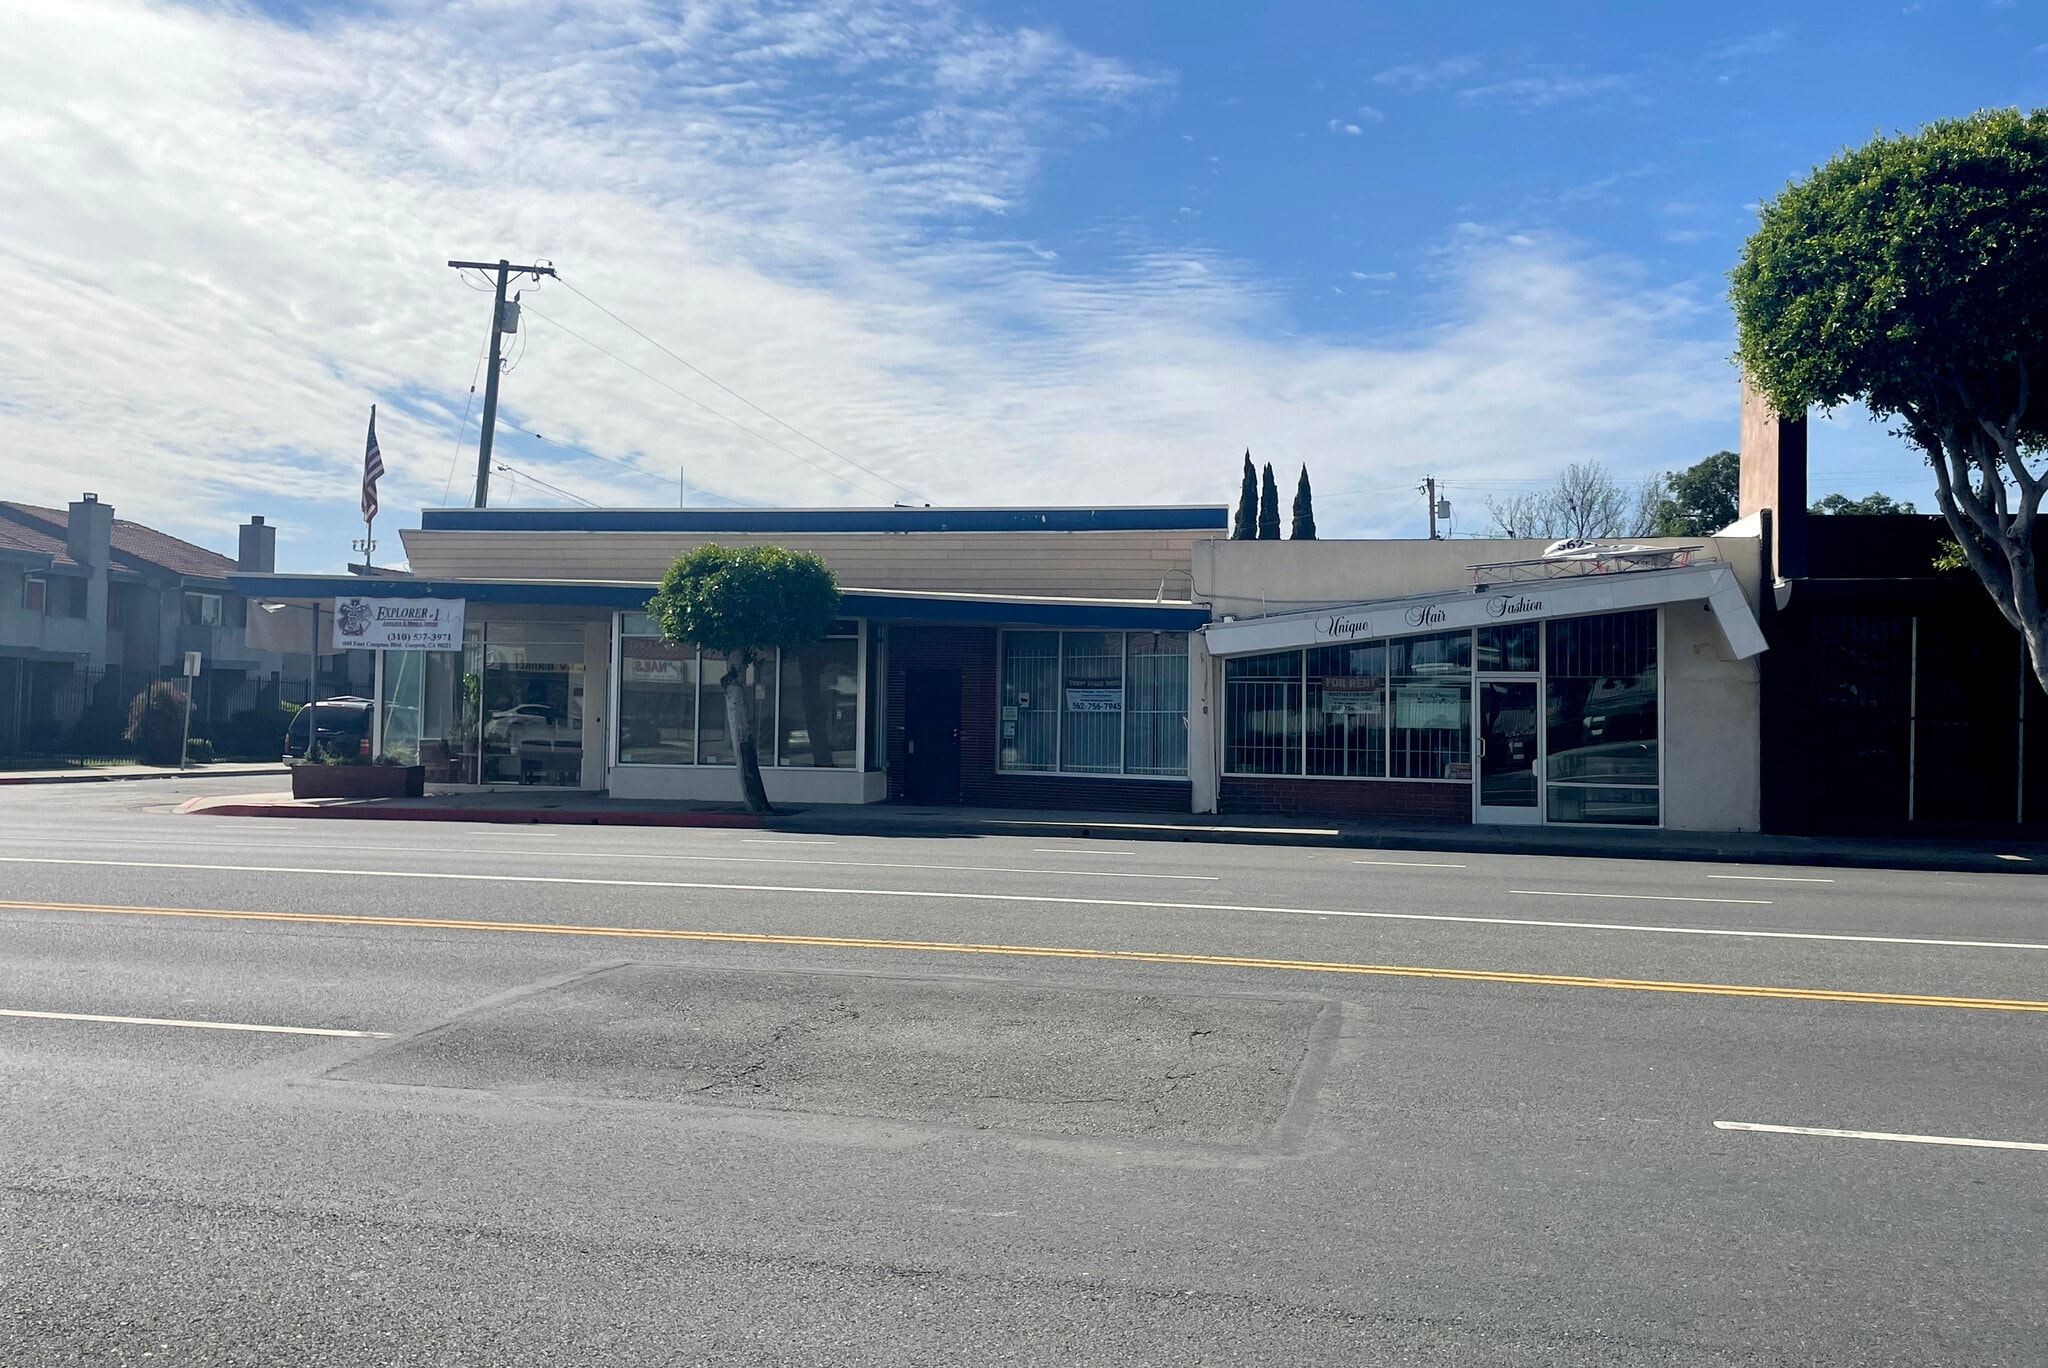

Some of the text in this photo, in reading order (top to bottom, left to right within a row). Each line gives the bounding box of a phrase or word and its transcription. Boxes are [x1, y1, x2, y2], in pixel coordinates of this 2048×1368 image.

[1315, 595, 1544, 639] Unique Hair Fashion
[387, 633, 452, 641] (310) 537-3971
[1325, 678, 1375, 688] FOR RENT
[1072, 702, 1122, 710] 562-756-7945
